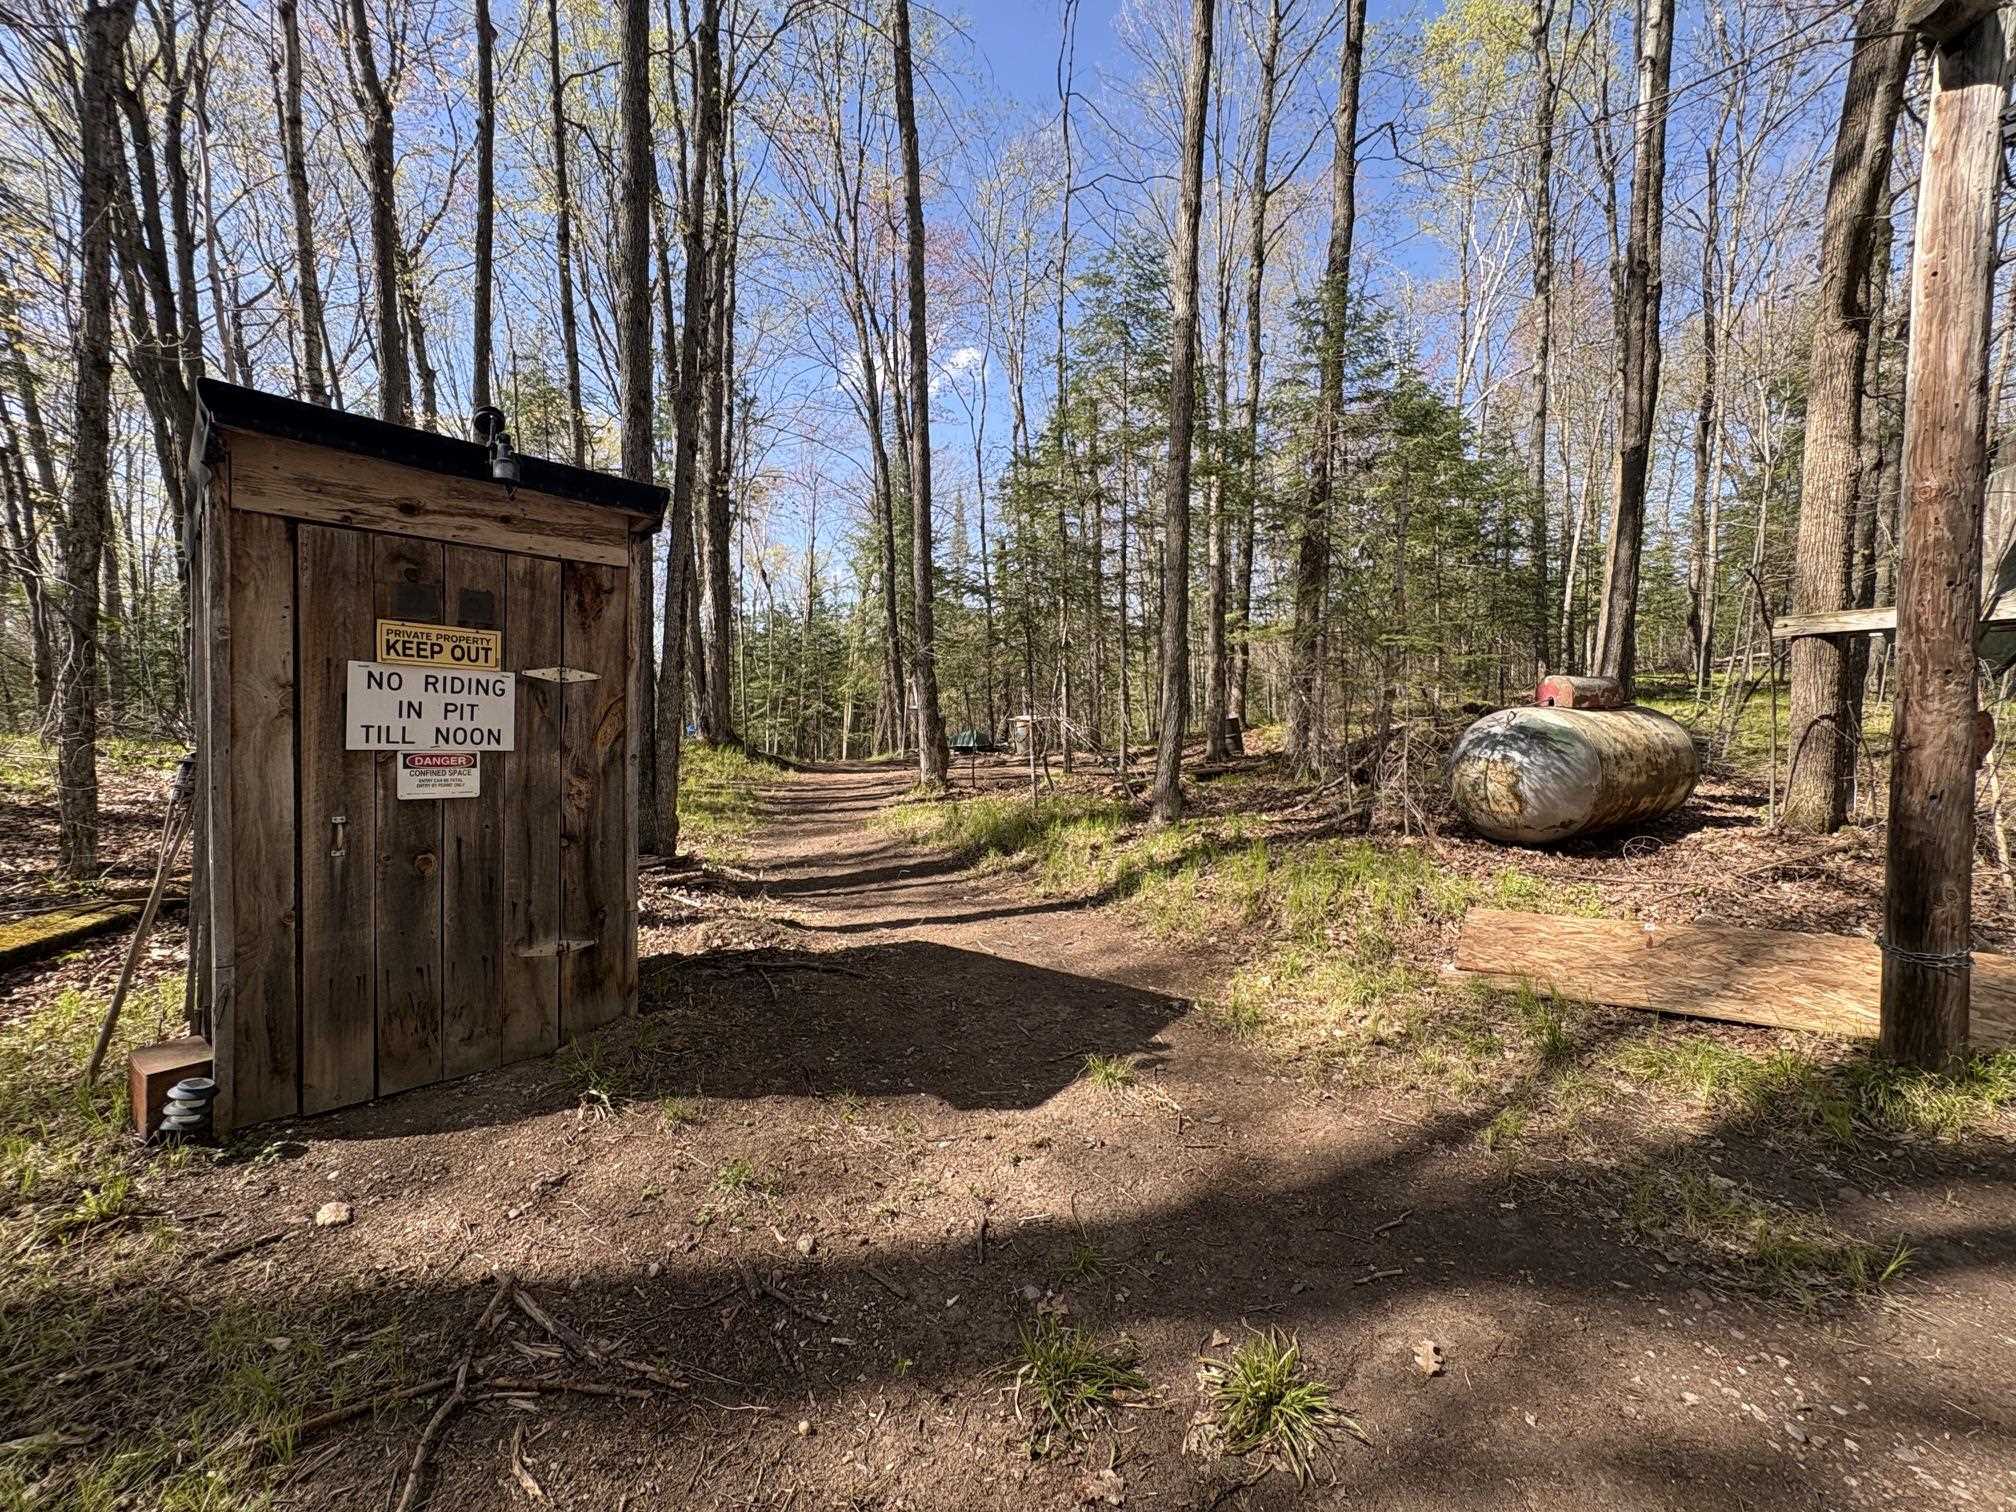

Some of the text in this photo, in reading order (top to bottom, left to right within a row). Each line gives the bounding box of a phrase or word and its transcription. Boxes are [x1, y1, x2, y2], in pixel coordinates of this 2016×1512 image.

[386, 628, 492, 646] PRIVATE PROPERTY
[385, 639, 493, 663] KEEP OUT
[367, 670, 506, 697] NO RIDING
[398, 700, 479, 721] IN PIT
[360, 724, 501, 746] TILL NOON
[414, 756, 467, 766] DANGER
[409, 769, 447, 777] CONFINED
